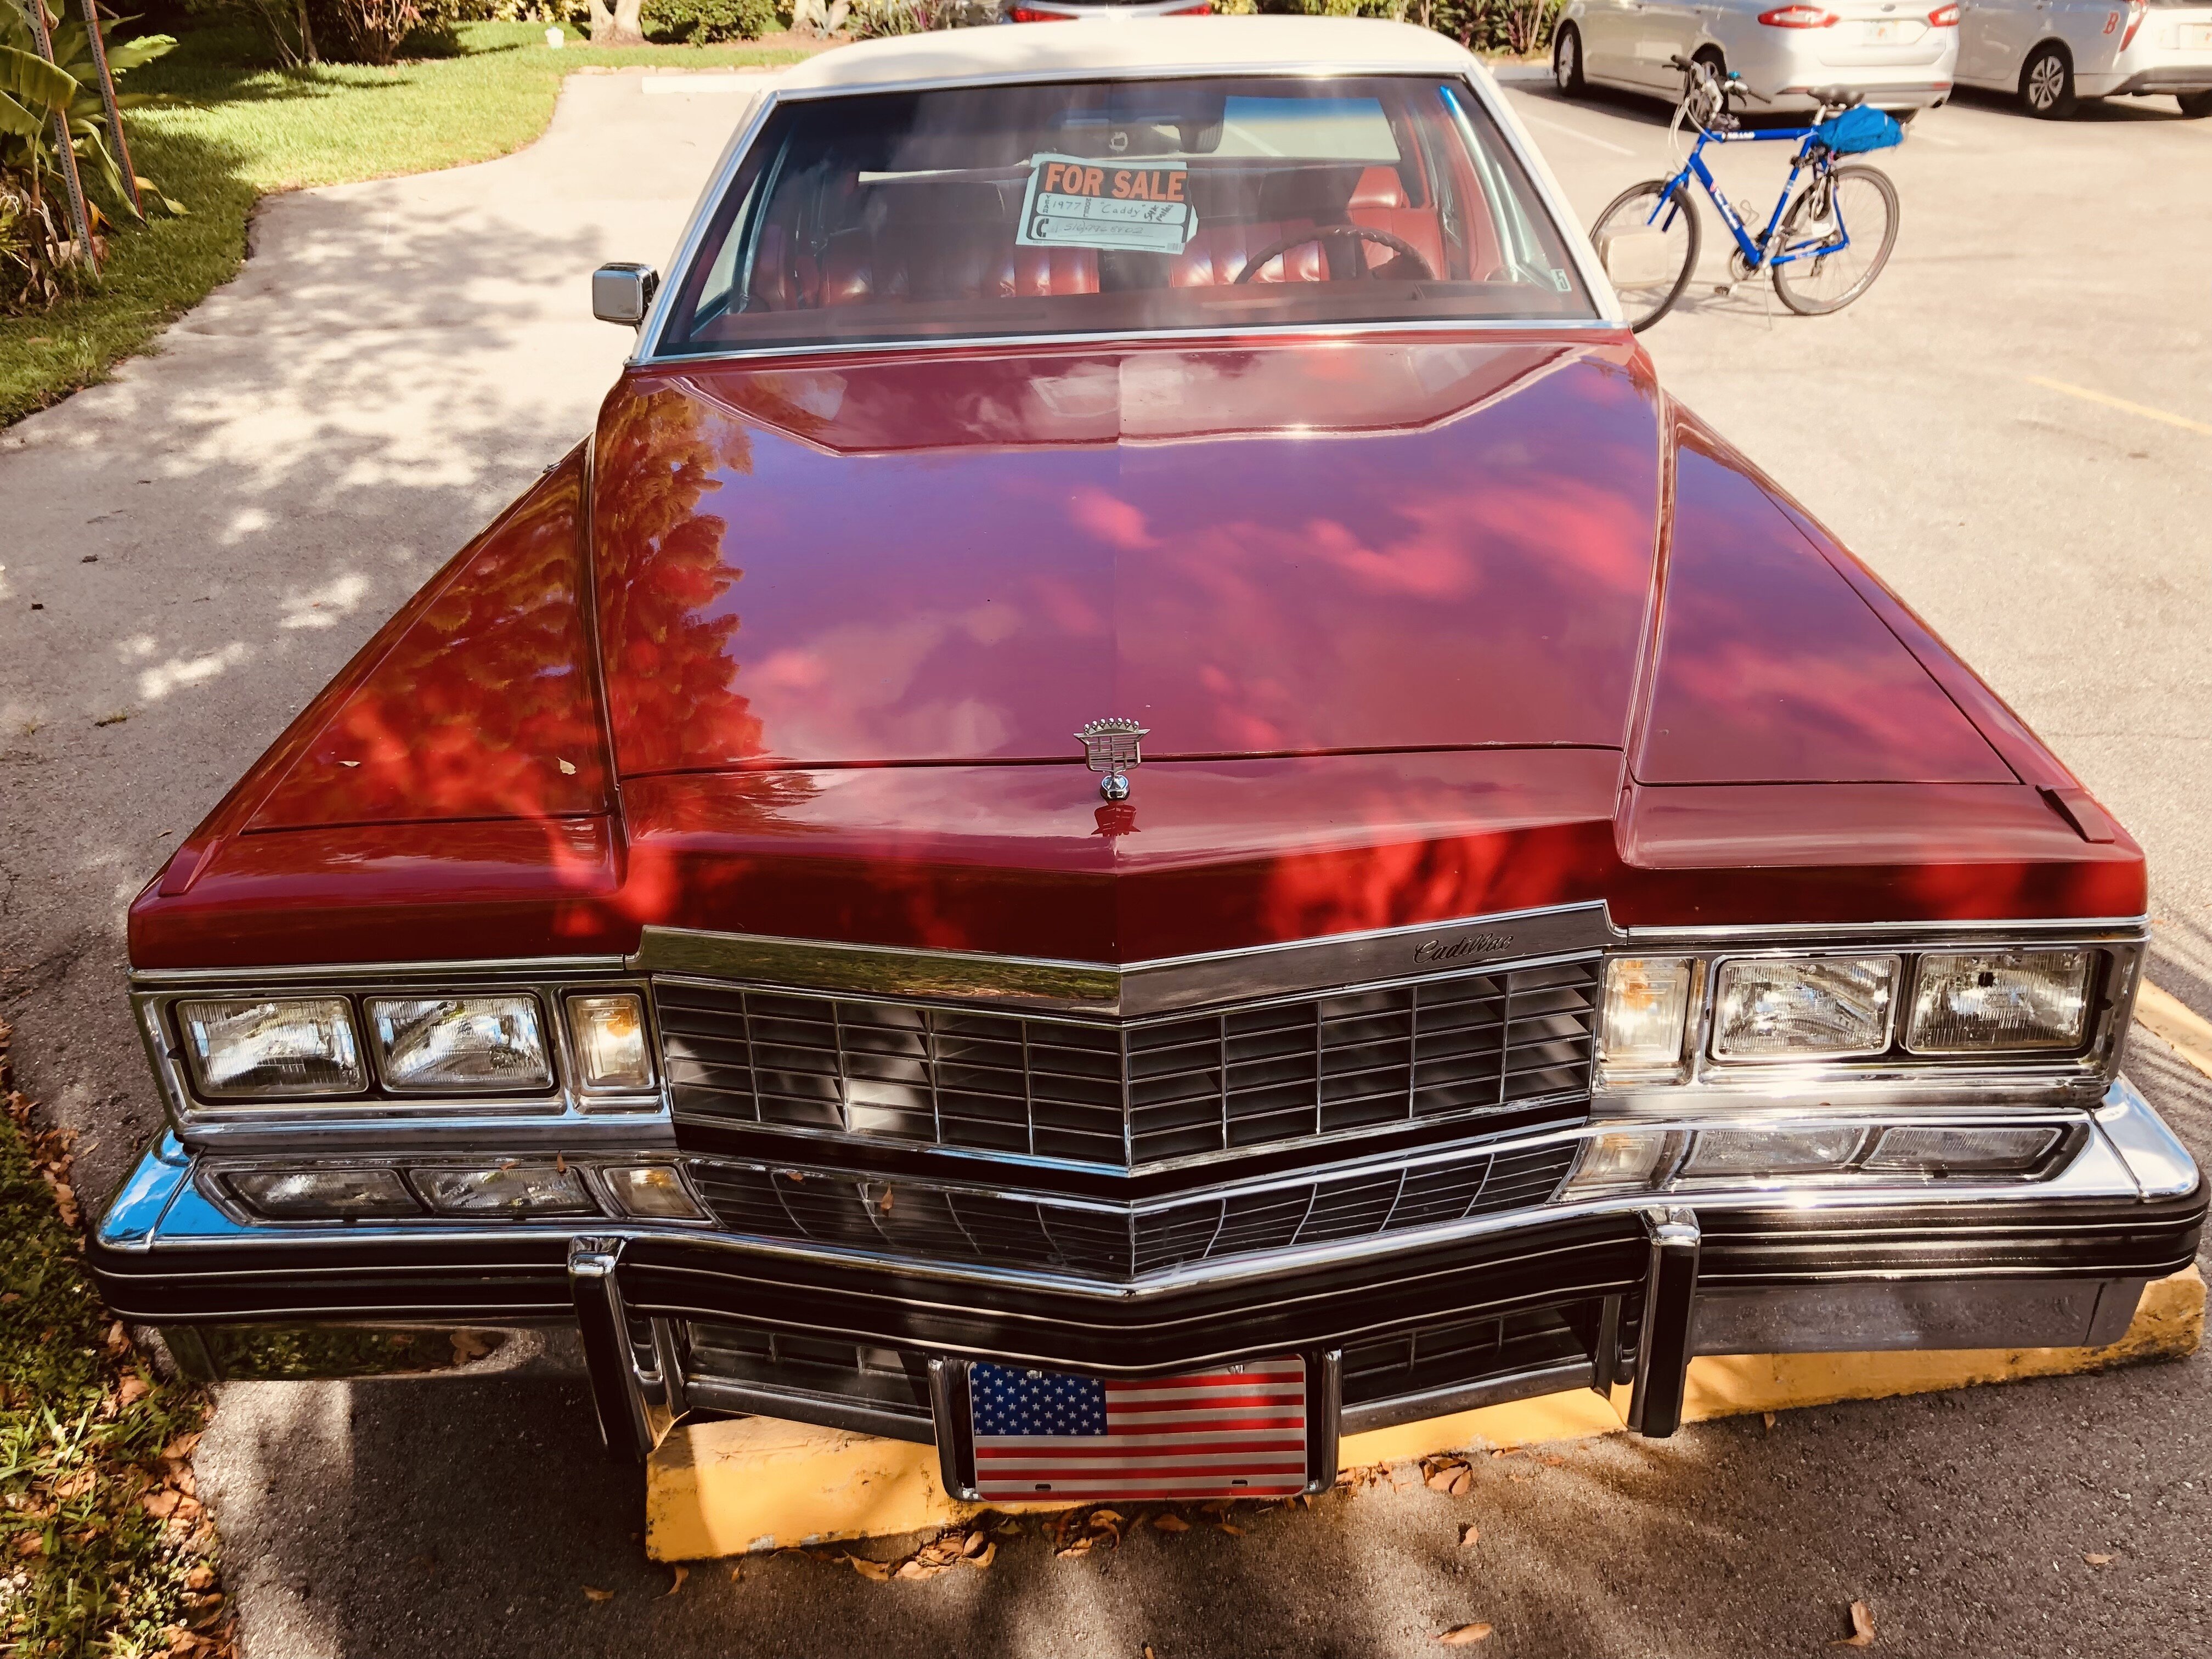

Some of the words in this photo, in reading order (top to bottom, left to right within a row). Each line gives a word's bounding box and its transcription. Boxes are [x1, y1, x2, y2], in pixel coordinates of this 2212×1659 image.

[1045, 163, 1104, 196] FOR
[1111, 170, 1187, 201] SALE
[1043, 194, 1051, 213] YEAR
[1053, 201, 1081, 210] 1977
[1083, 198, 1091, 218] MODEL
[1413, 933, 1514, 964] Cadillac
